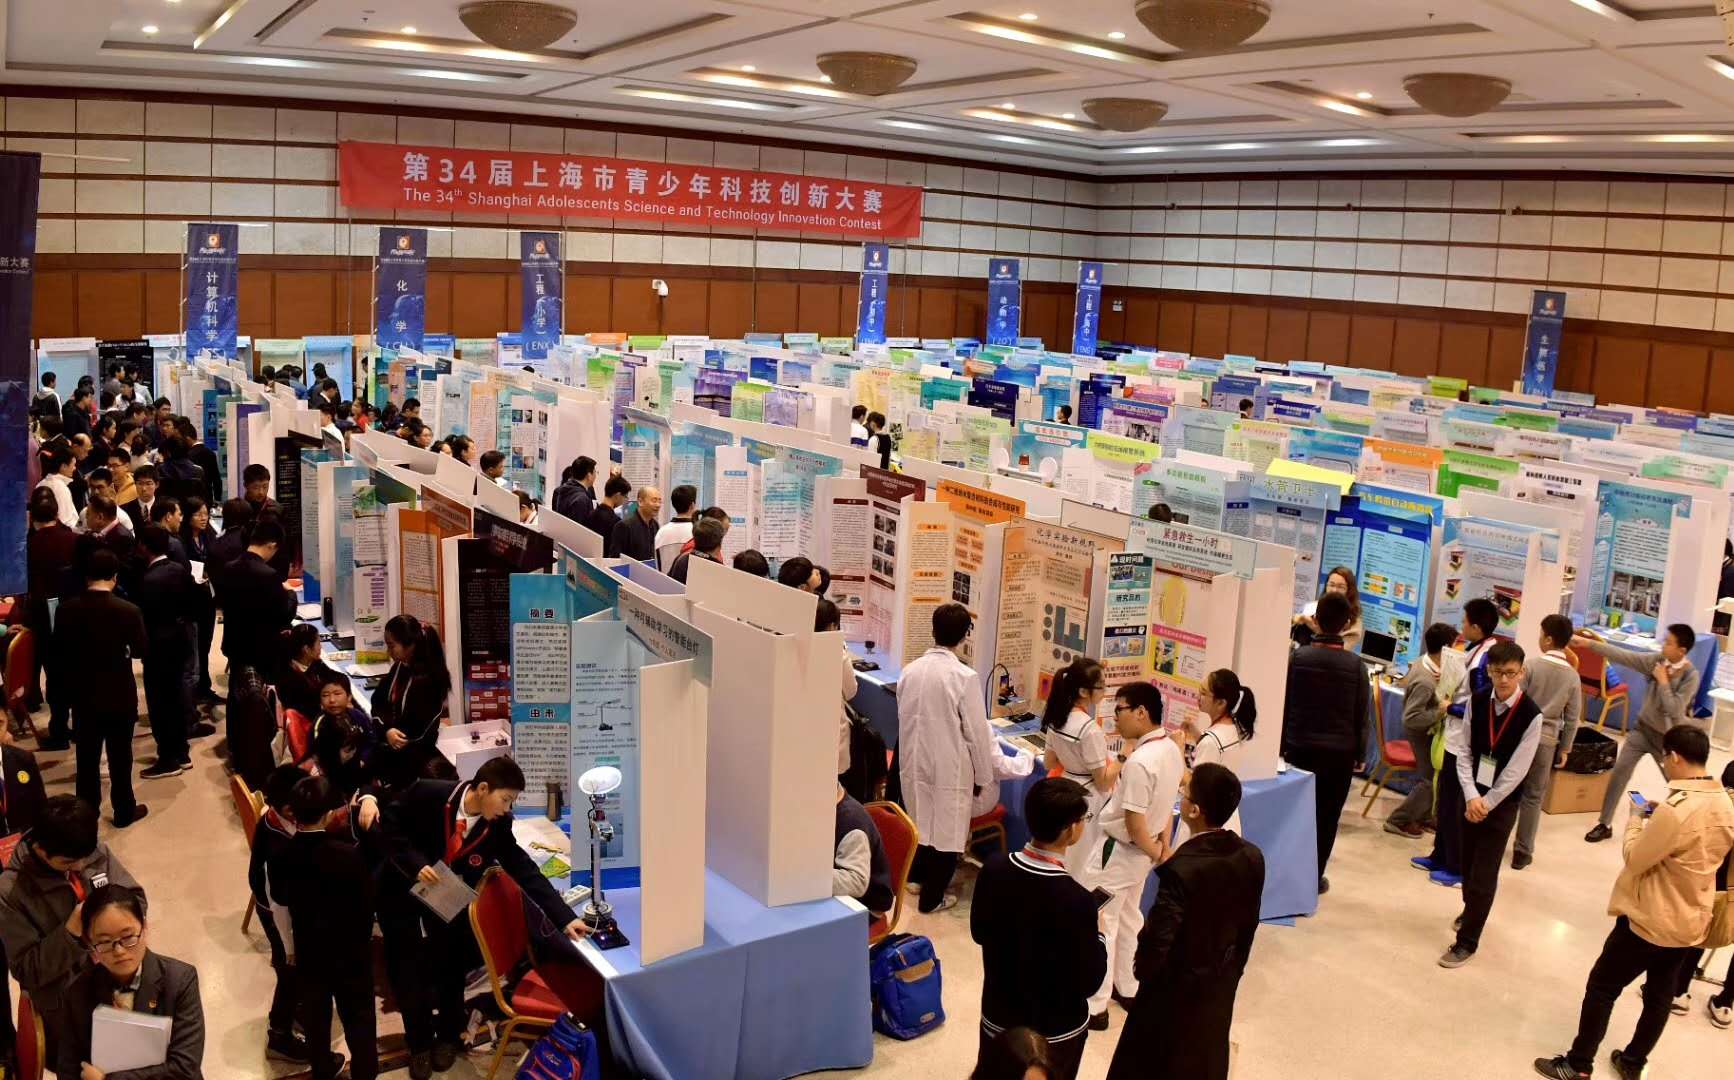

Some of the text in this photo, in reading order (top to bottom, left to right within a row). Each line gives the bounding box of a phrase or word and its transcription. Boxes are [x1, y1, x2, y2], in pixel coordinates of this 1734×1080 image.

[403, 151, 883, 214] 第34届上海市青少年科技创新大赛
[403, 187, 882, 231] The 34th Shanghai Adolescents Science and Technology Innovation Contest
[206, 271, 219, 341] 计算机科学
[396, 280, 408, 332] 化学
